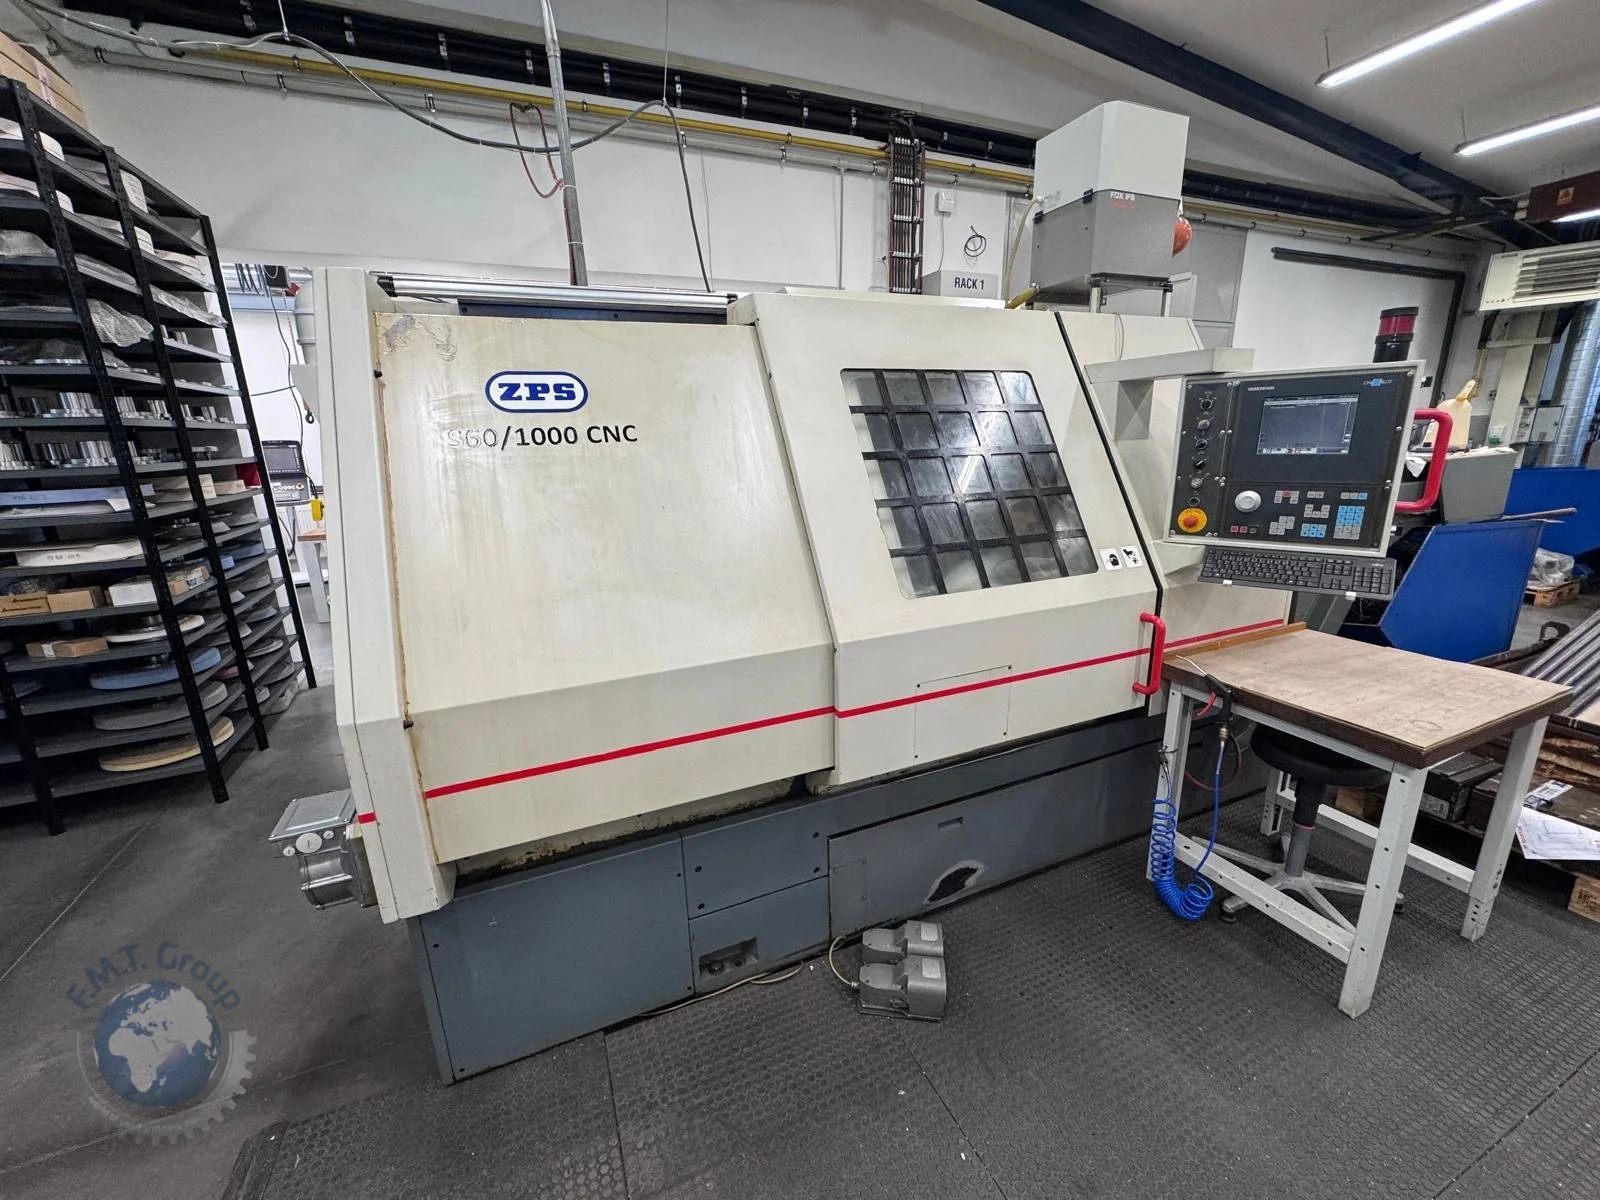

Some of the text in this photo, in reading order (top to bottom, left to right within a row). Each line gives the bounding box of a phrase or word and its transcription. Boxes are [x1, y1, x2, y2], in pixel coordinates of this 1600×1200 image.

[1110, 191, 1124, 200] FOX
[954, 276, 985, 290] RACK 1
[498, 383, 577, 401] ZPS
[587, 425, 638, 443] CNC
